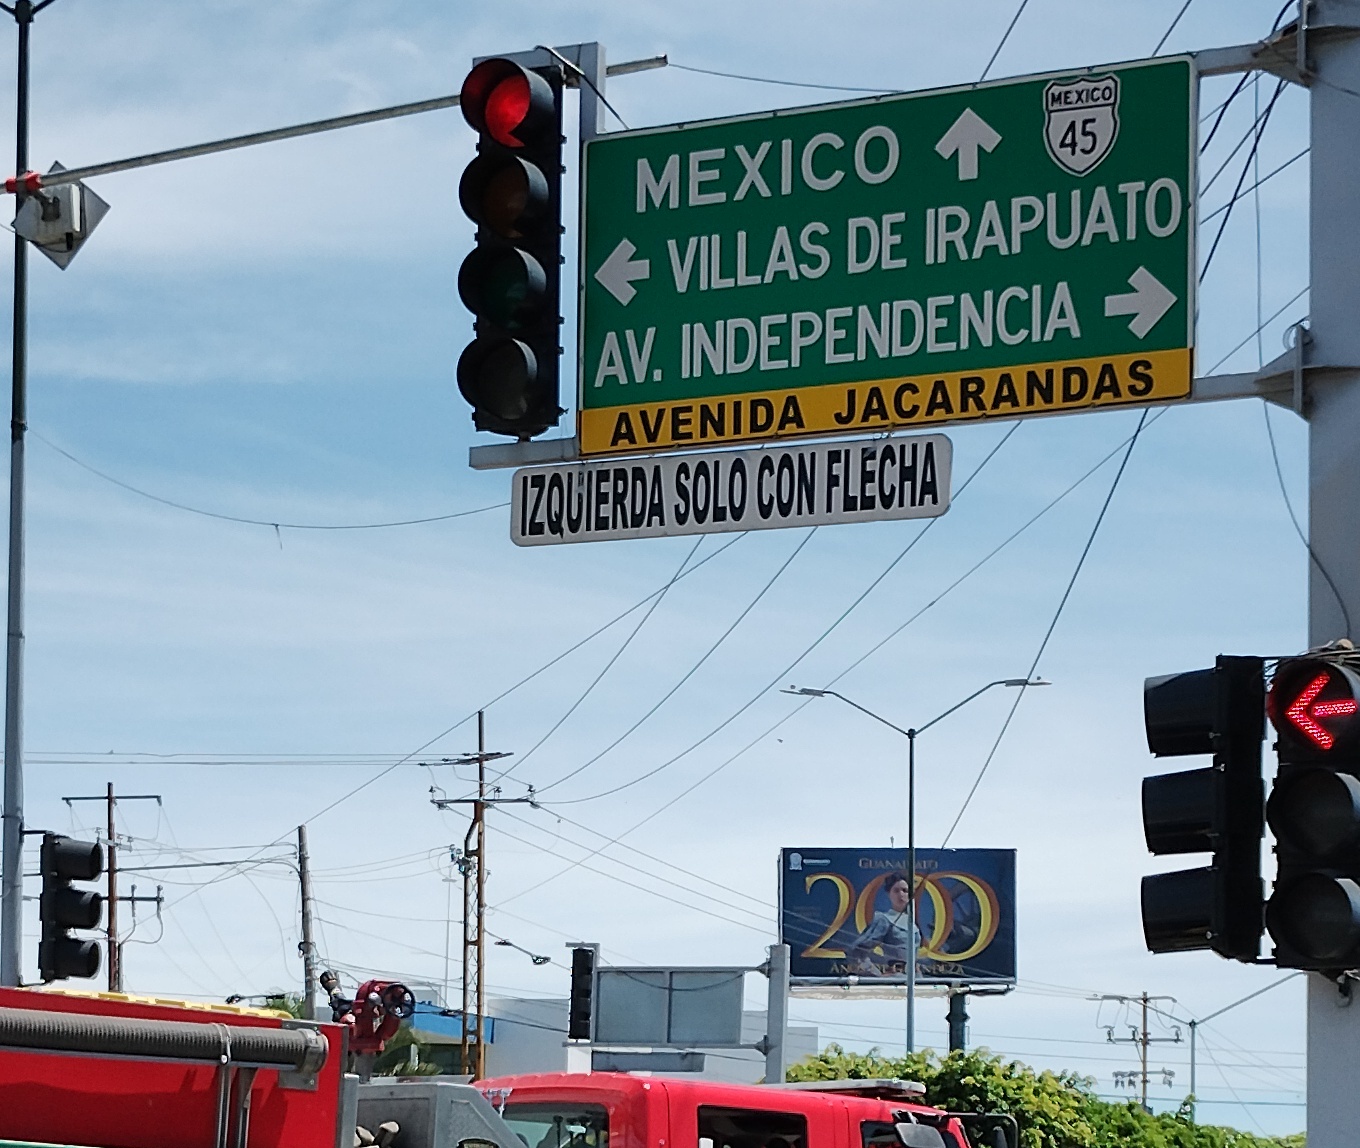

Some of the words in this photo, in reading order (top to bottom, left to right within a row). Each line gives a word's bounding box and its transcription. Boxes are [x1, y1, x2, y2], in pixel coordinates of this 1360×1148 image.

[1051, 86, 1113, 107] MEXICO
[1059, 118, 1097, 156] 45
[636, 125, 900, 213] MEXICO
[667, 221, 830, 294] VILLAS
[848, 214, 906, 274] DE
[926, 177, 1182, 265] IRAPUATO
[595, 327, 662, 388] AV.
[682, 282, 1081, 379] INDEPENDENCIA
[610, 395, 806, 448] AVENIDA
[834, 360, 1155, 428] JACARANDAS
[519, 463, 665, 540] IZQUIERDA
[674, 456, 748, 526] SOLO
[756, 450, 816, 517] CON
[826, 441, 939, 514] FLECHA
